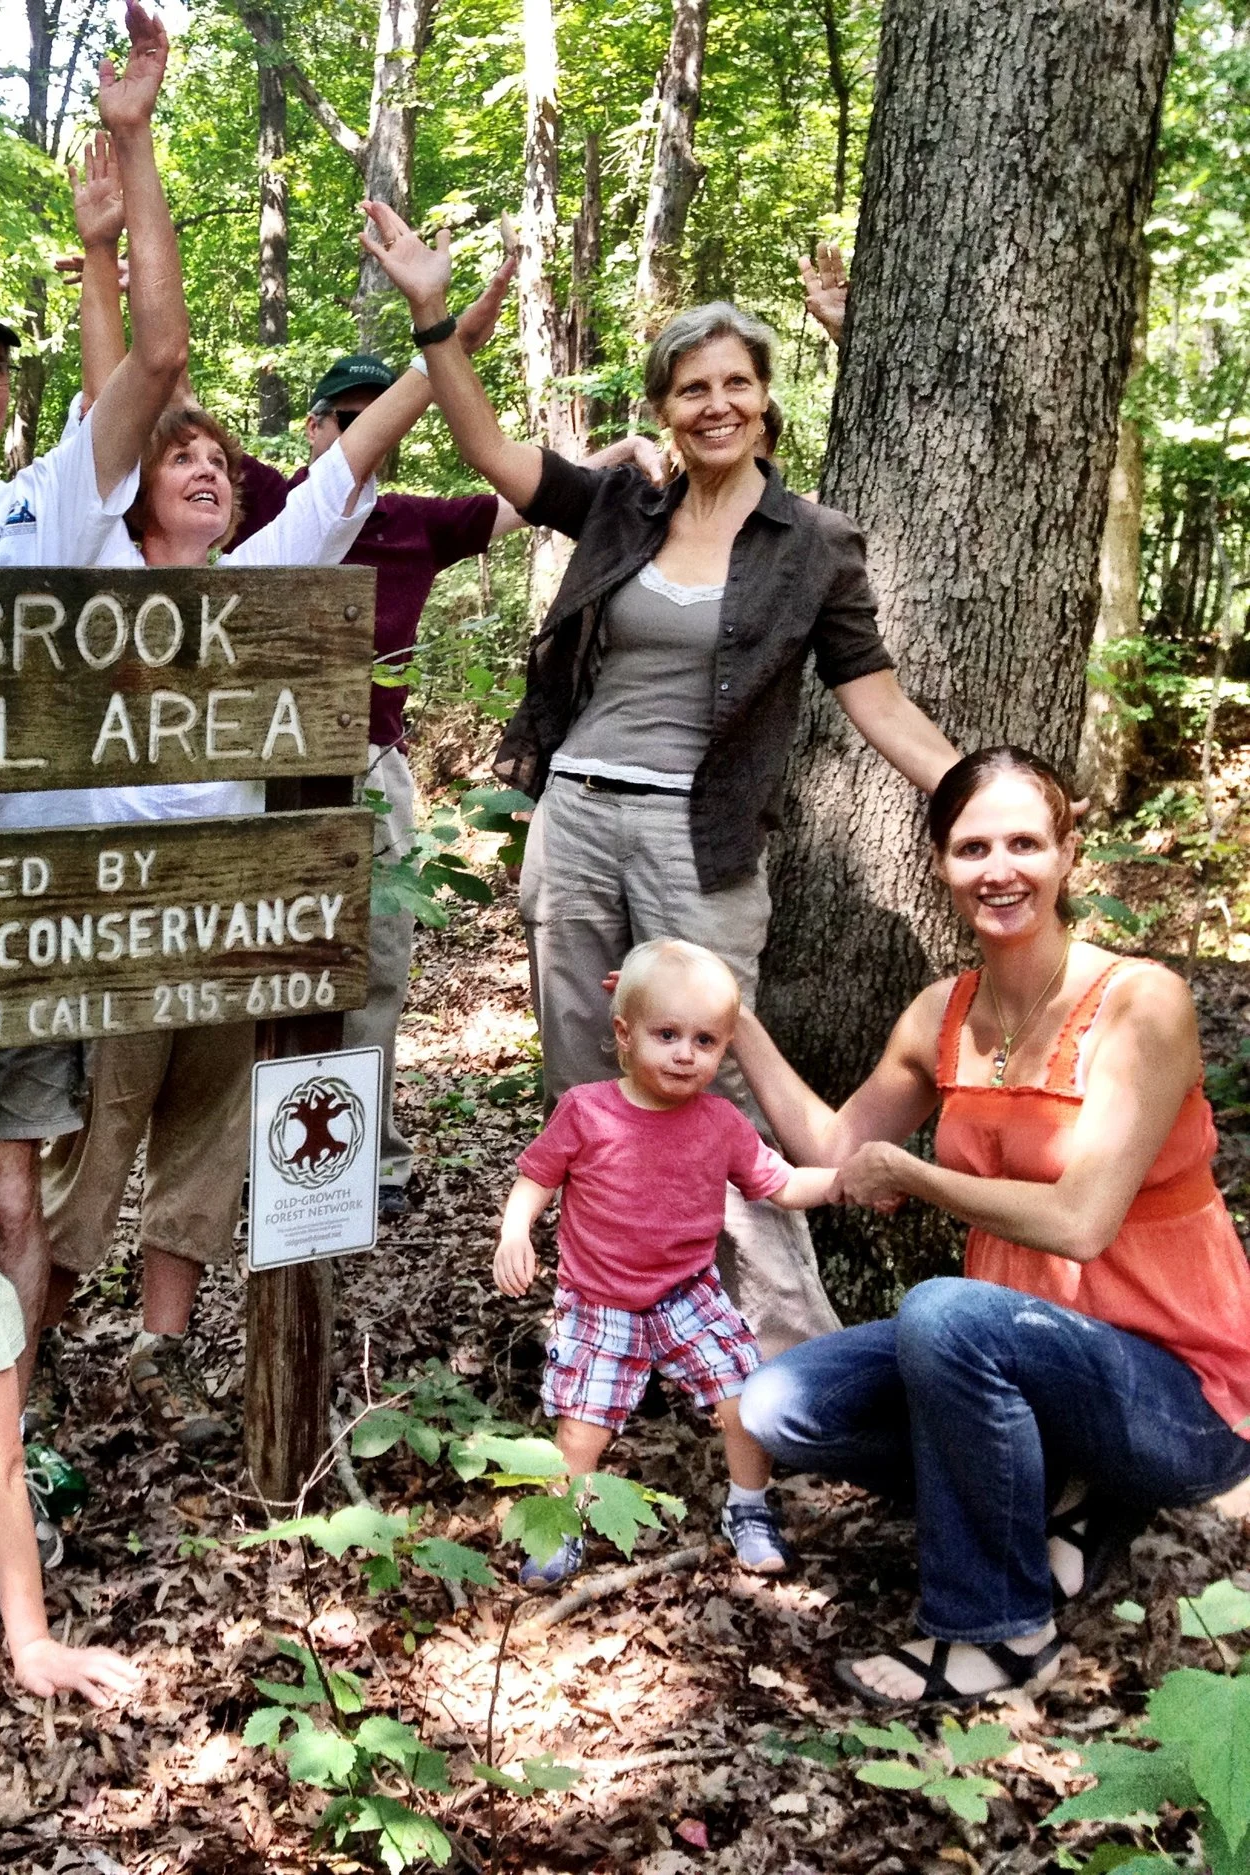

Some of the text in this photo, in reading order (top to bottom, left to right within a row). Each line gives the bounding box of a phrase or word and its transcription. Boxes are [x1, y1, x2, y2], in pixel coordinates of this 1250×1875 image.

[91, 687, 307, 765] AREA
[97, 849, 157, 893] BY
[28, 990, 124, 1038] CALL
[152, 969, 337, 1025] 295-6106
[265, 1208, 305, 1225] FOREST
[307, 1199, 363, 1218] NETWORK
[273, 1188, 351, 1211] OLD-GROWTH
